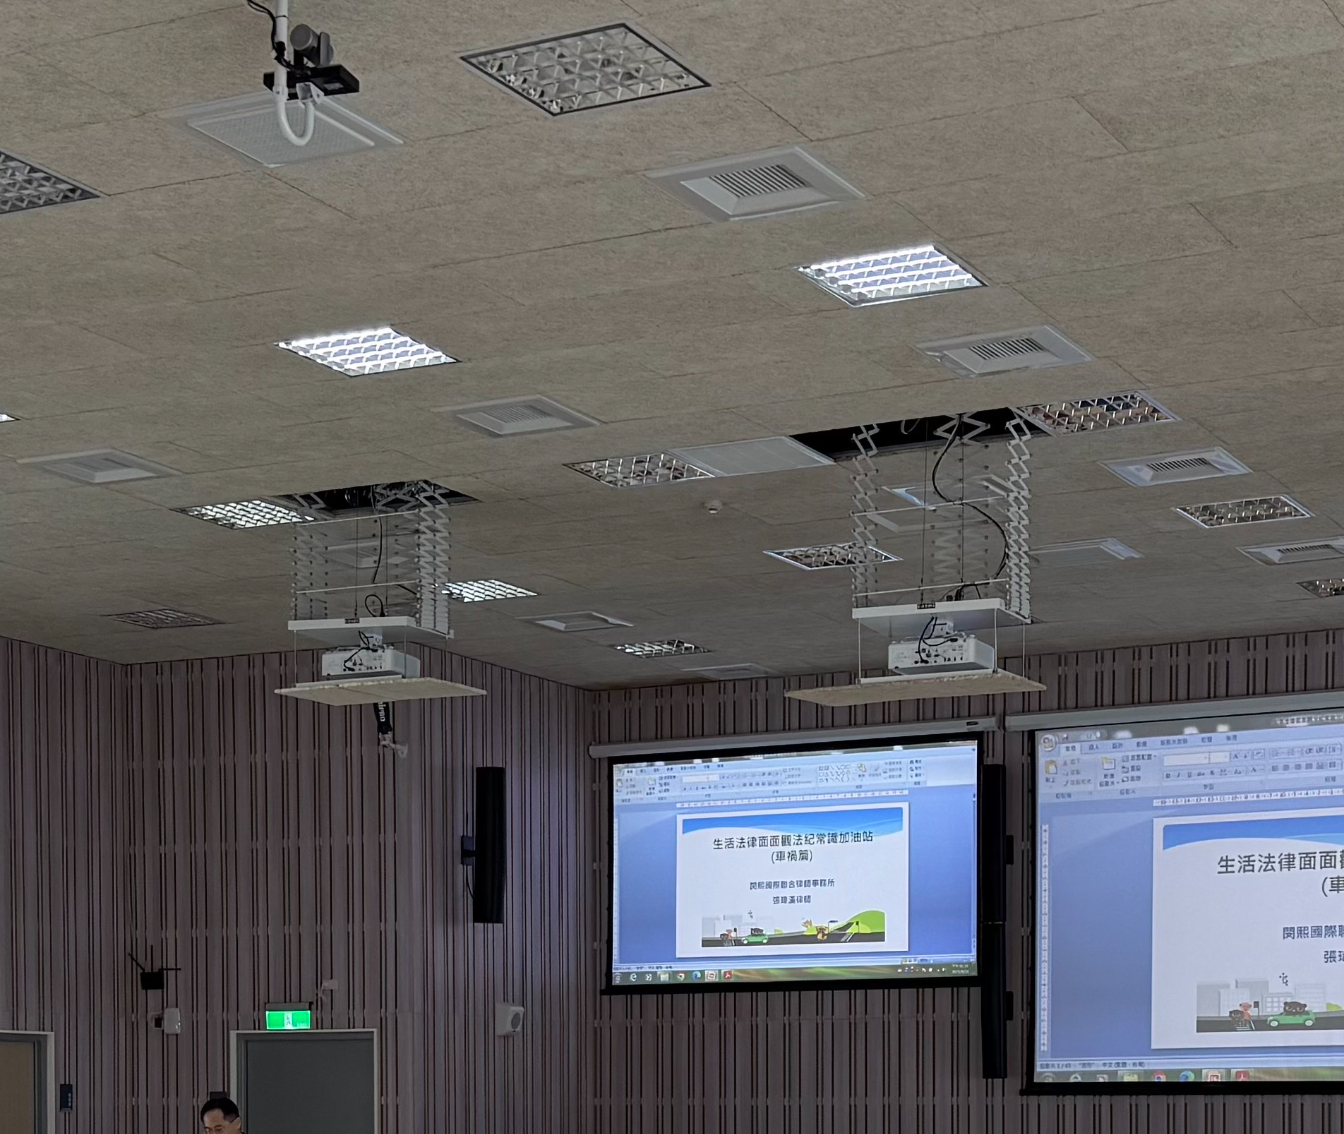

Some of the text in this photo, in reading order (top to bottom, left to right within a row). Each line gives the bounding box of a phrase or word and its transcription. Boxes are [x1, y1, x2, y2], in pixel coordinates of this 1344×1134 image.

[712, 831, 873, 850] 生活法律面面觀法紀常識加油站
[771, 850, 813, 864] (車禍篇)
